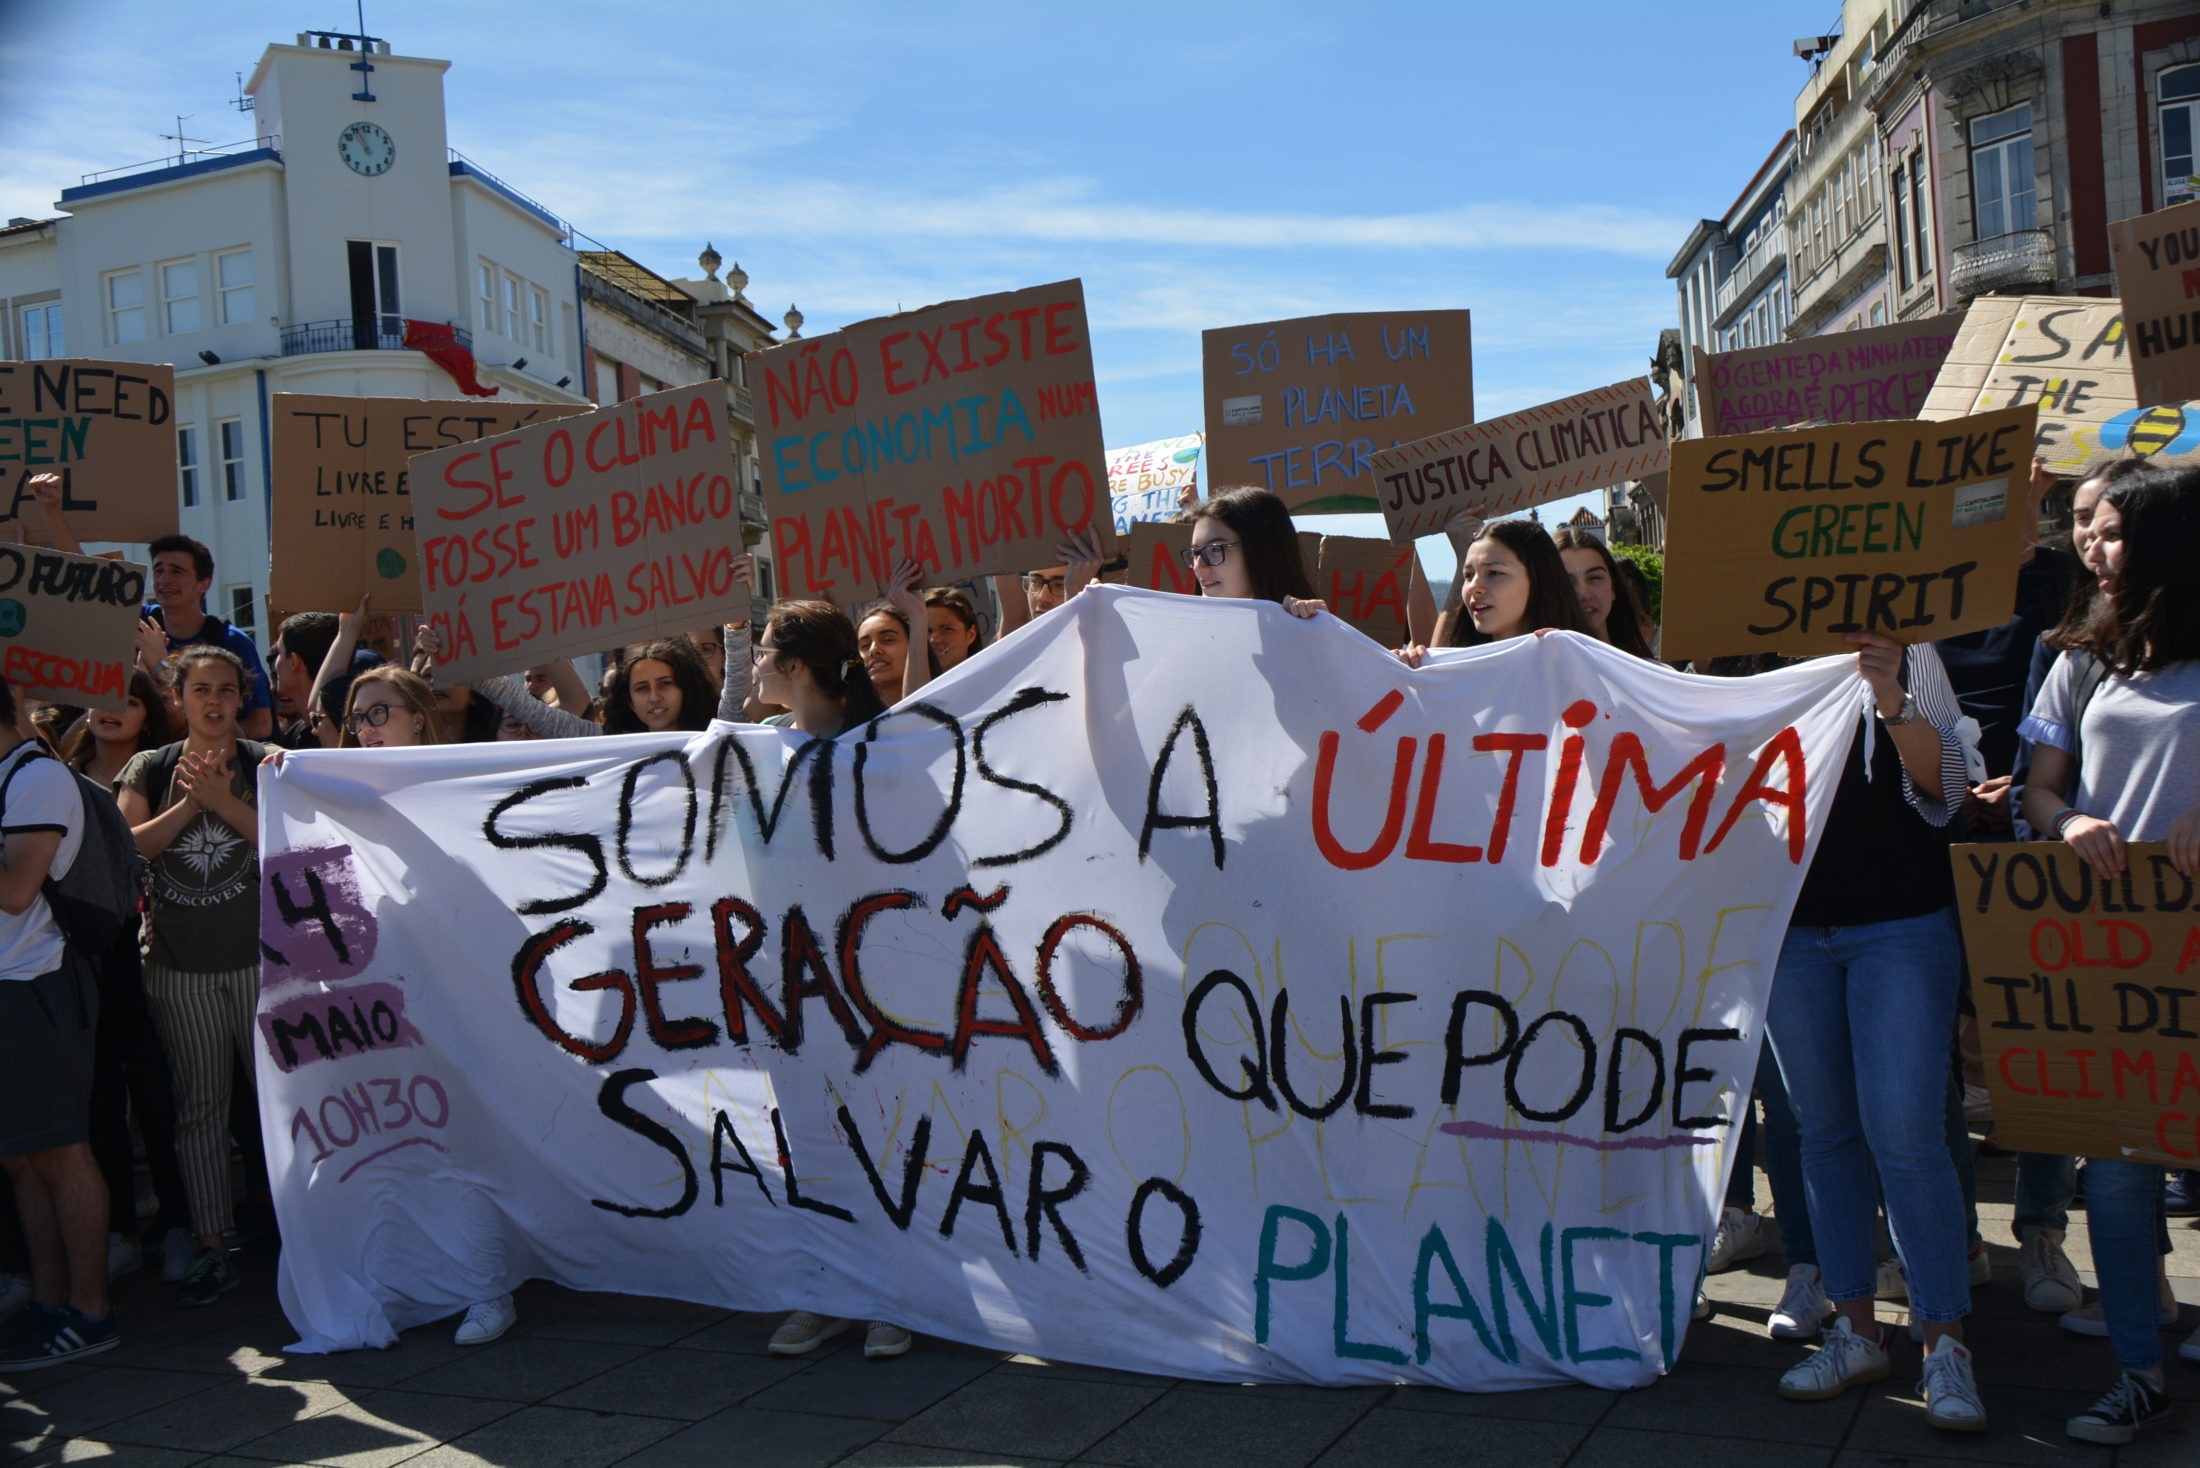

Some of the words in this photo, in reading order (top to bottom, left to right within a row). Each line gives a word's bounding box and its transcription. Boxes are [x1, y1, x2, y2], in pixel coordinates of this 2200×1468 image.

[764, 341, 859, 428] NÃO
[879, 301, 1080, 395] EXISTE
[1231, 329, 1280, 376] SÓ
[1306, 323, 1355, 366] HÁ
[1380, 325, 1431, 362] UM
[2136, 310, 2200, 359] HU
[33, 365, 170, 426] NEED
[1734, 355, 1807, 388] GENTE
[2008, 374, 2098, 414] THE
[291, 411, 369, 449] TU
[403, 409, 541, 451] EST
[772, 386, 1036, 495] ECONOMIA
[1037, 380, 1096, 422] NUM
[1280, 383, 1417, 430] PLANETA
[316, 466, 386, 497] LIVRE
[436, 439, 526, 521] SE
[544, 429, 575, 488] O
[585, 397, 717, 473] CLIMA
[1108, 456, 1171, 478] REES
[1114, 451, 1154, 464] THE
[1138, 468, 1190, 492] BUSY
[1248, 437, 1403, 493] TERR
[1384, 443, 1513, 512] JUSTIÇA
[1515, 399, 1664, 472] CLIMÁTICA
[1700, 438, 1887, 491] SMELLS
[1906, 424, 2021, 488] LIKE
[315, 509, 366, 530] LIVRE
[379, 513, 390, 531] E
[423, 518, 540, 593] FOSSE
[552, 503, 600, 559] UM
[610, 471, 733, 549] BANCO
[774, 497, 942, 598] PLANETA
[942, 456, 1096, 569] MORTO
[1771, 501, 1926, 560] GREEN
[28, 553, 145, 607] FUTURO
[428, 592, 478, 667] JÁ
[491, 571, 620, 652] ESTAVA
[623, 544, 735, 617] SALVO
[1329, 549, 1412, 625] HÁ
[1747, 561, 1978, 636] SPIRIT
[482, 686, 1076, 915] SOMOS
[1138, 703, 1226, 870] A
[1311, 689, 1808, 870] ÚLTIMA
[163, 881, 249, 908] DISCOVER
[1967, 852, 2147, 914] YOULL
[259, 867, 353, 966] 4
[2029, 917, 2153, 973] OLD
[511, 880, 1145, 1080] GERAÇÃO
[1983, 971, 2095, 1034] I'LL
[271, 999, 399, 1067] MAIO
[1181, 969, 1419, 1122] QUE
[1440, 989, 1742, 1133] PODE
[290, 1074, 450, 1164] 10H30
[591, 1067, 1092, 1279] SALVAR
[1126, 1176, 1203, 1289] O
[1254, 1203, 1707, 1374] PLANET
